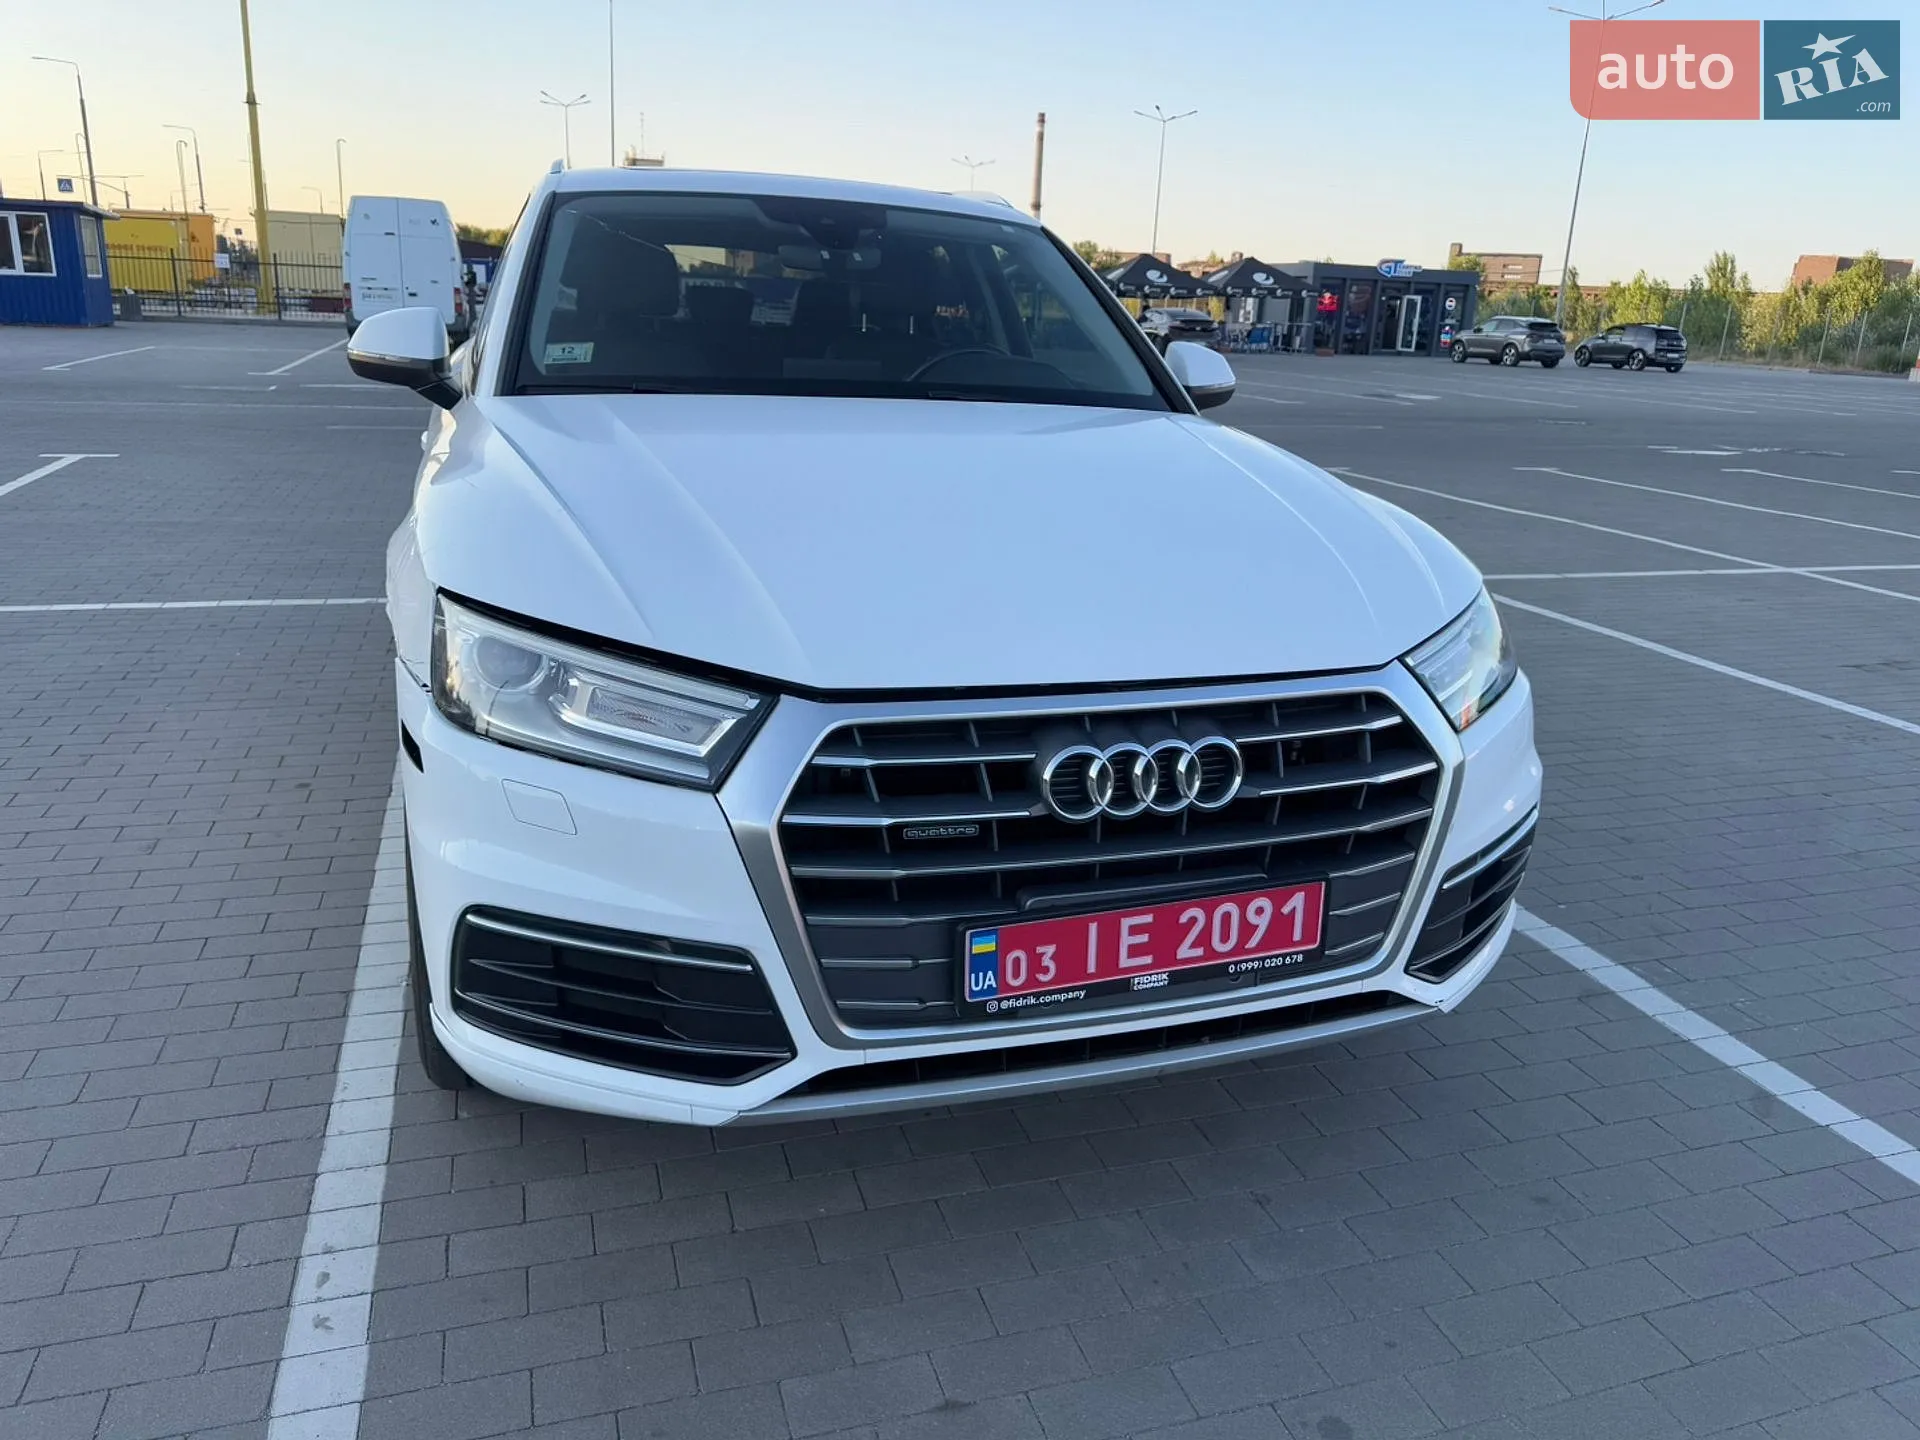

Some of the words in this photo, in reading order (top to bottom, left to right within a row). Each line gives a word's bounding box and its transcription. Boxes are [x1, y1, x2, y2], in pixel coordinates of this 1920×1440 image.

[561, 346, 575, 354] 12
[907, 828, 976, 839] quattro
[1005, 943, 1057, 987] 03
[1086, 913, 1154, 974] IE
[1176, 891, 1305, 960] 2091
[1228, 964, 1236, 973] 0
[1237, 960, 1262, 973] (999)
[1264, 957, 1283, 969] 020
[1285, 953, 1304, 965] 678
[970, 970, 997, 992] UA
[1133, 980, 1169, 990] COMPANY
[1134, 972, 1170, 985] FIDRIK
[1000, 989, 1087, 1009] @fidrik.company
